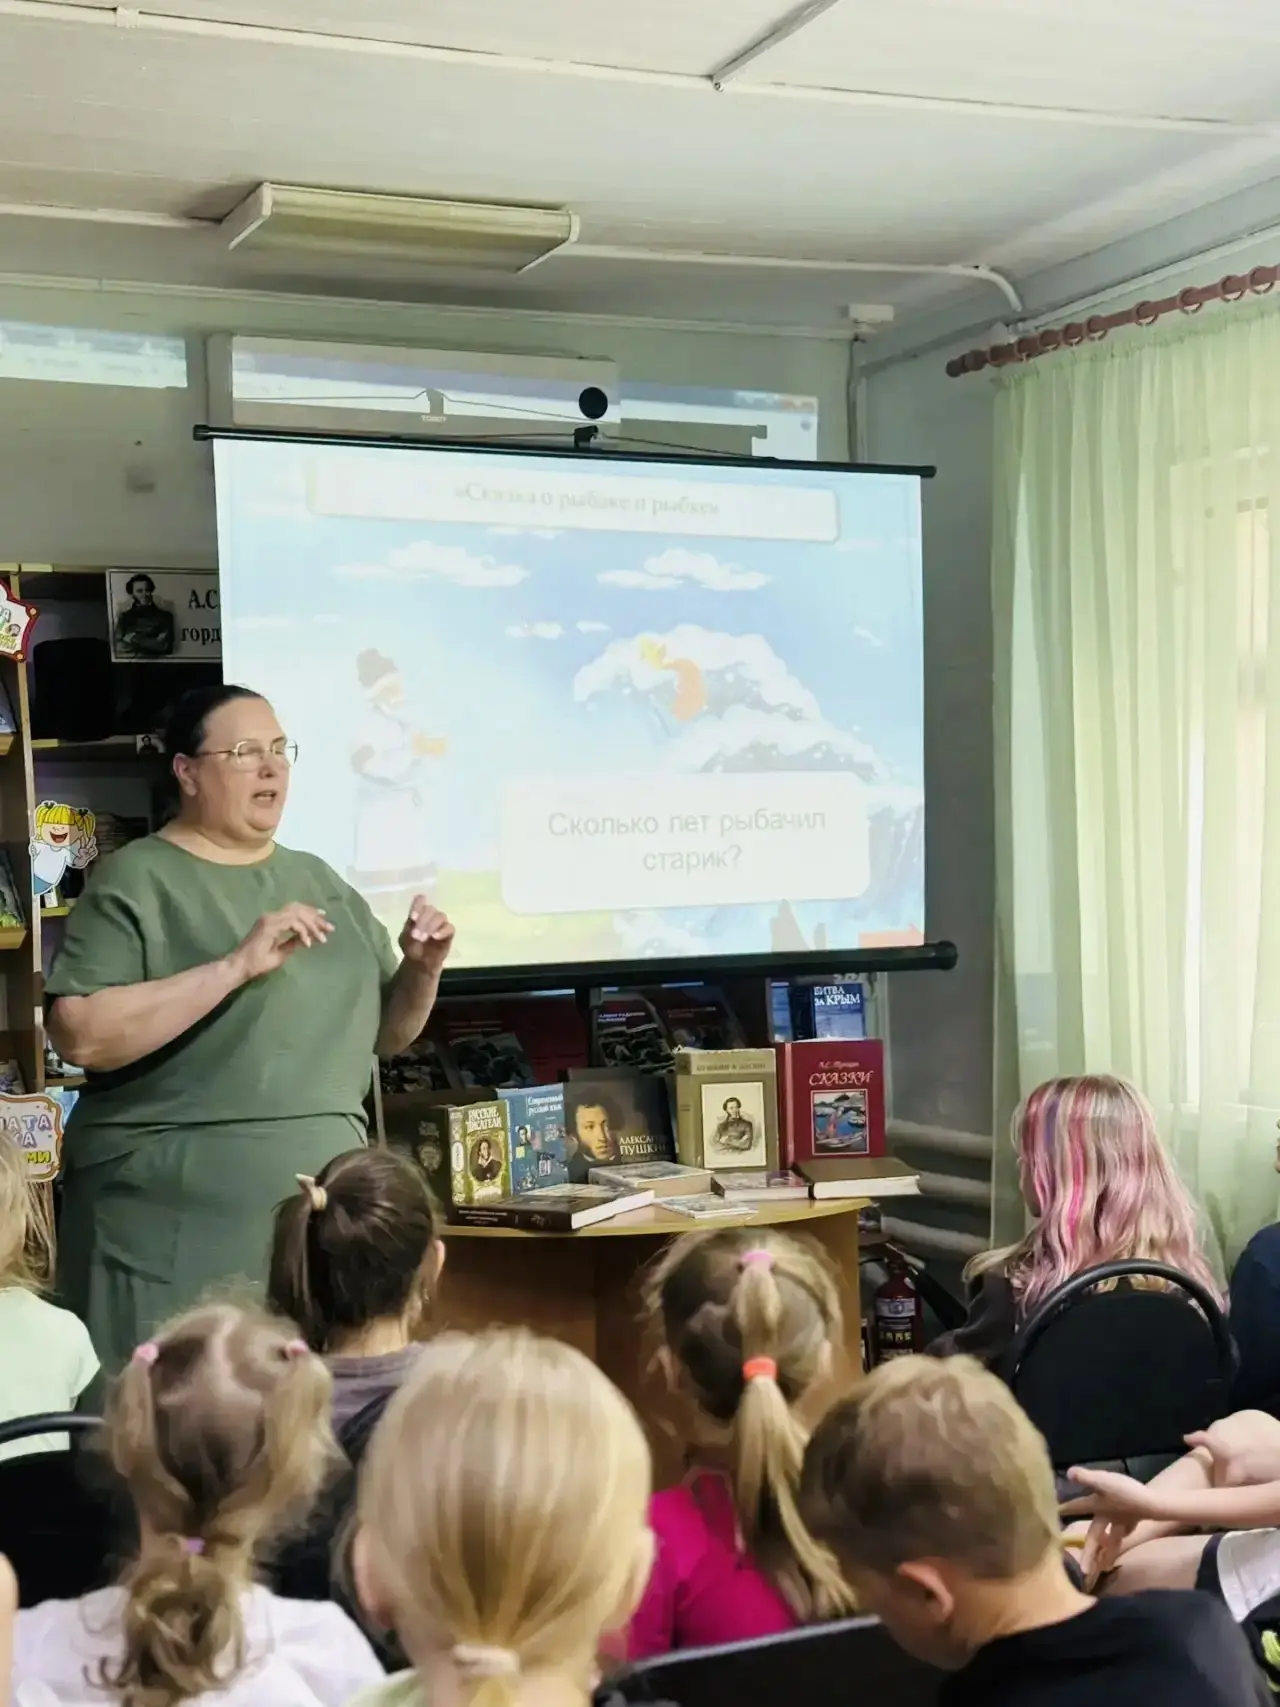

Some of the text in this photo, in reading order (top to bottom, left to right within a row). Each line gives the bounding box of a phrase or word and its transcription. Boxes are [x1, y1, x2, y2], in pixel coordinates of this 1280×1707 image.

[541, 491, 553, 506] о
[559, 489, 629, 513] рыбаке
[548, 811, 660, 837] Сколько
[719, 808, 827, 837] рыбачил
[642, 844, 743, 876] старик?
[814, 985, 845, 996] БИТВА
[826, 993, 861, 1006] КРЫМ
[808, 1070, 874, 1087] СКАЗКИ
[619, 1134, 667, 1146] АЛЕКСА
[619, 1143, 669, 1156] ПУШКИН
